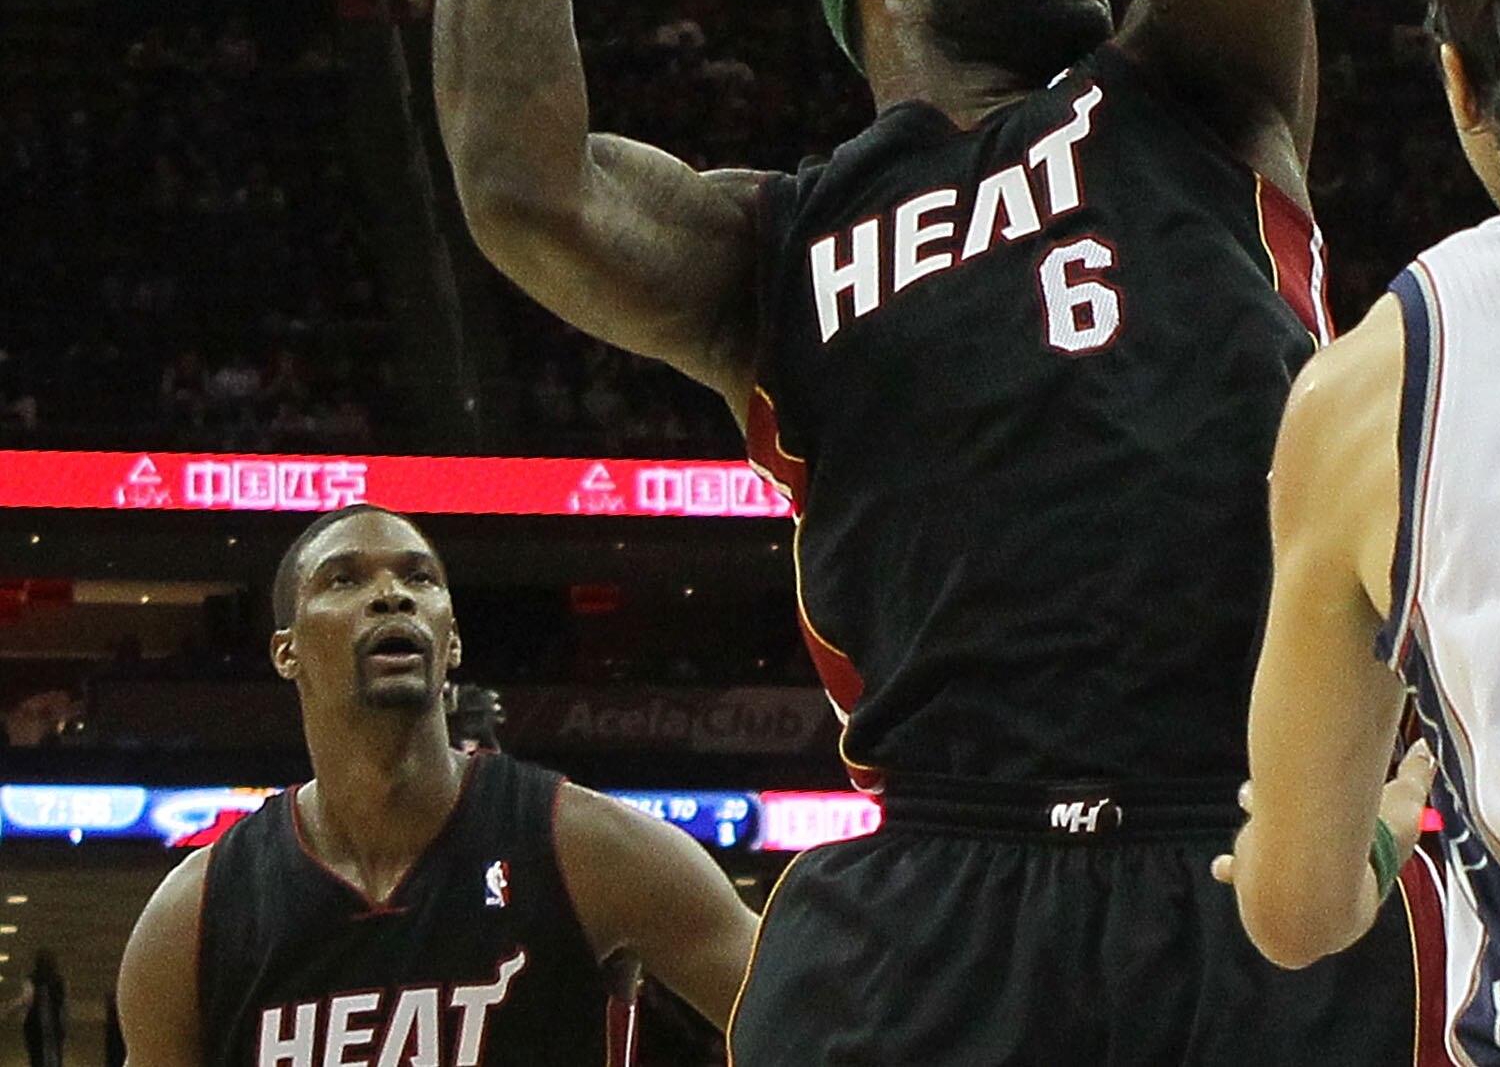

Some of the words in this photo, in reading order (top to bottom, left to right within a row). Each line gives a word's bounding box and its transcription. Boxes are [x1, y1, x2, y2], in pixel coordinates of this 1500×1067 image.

[809, 84, 1103, 344] HEAT
[1038, 237, 1122, 356] 6
[258, 951, 526, 1067] HEAT
